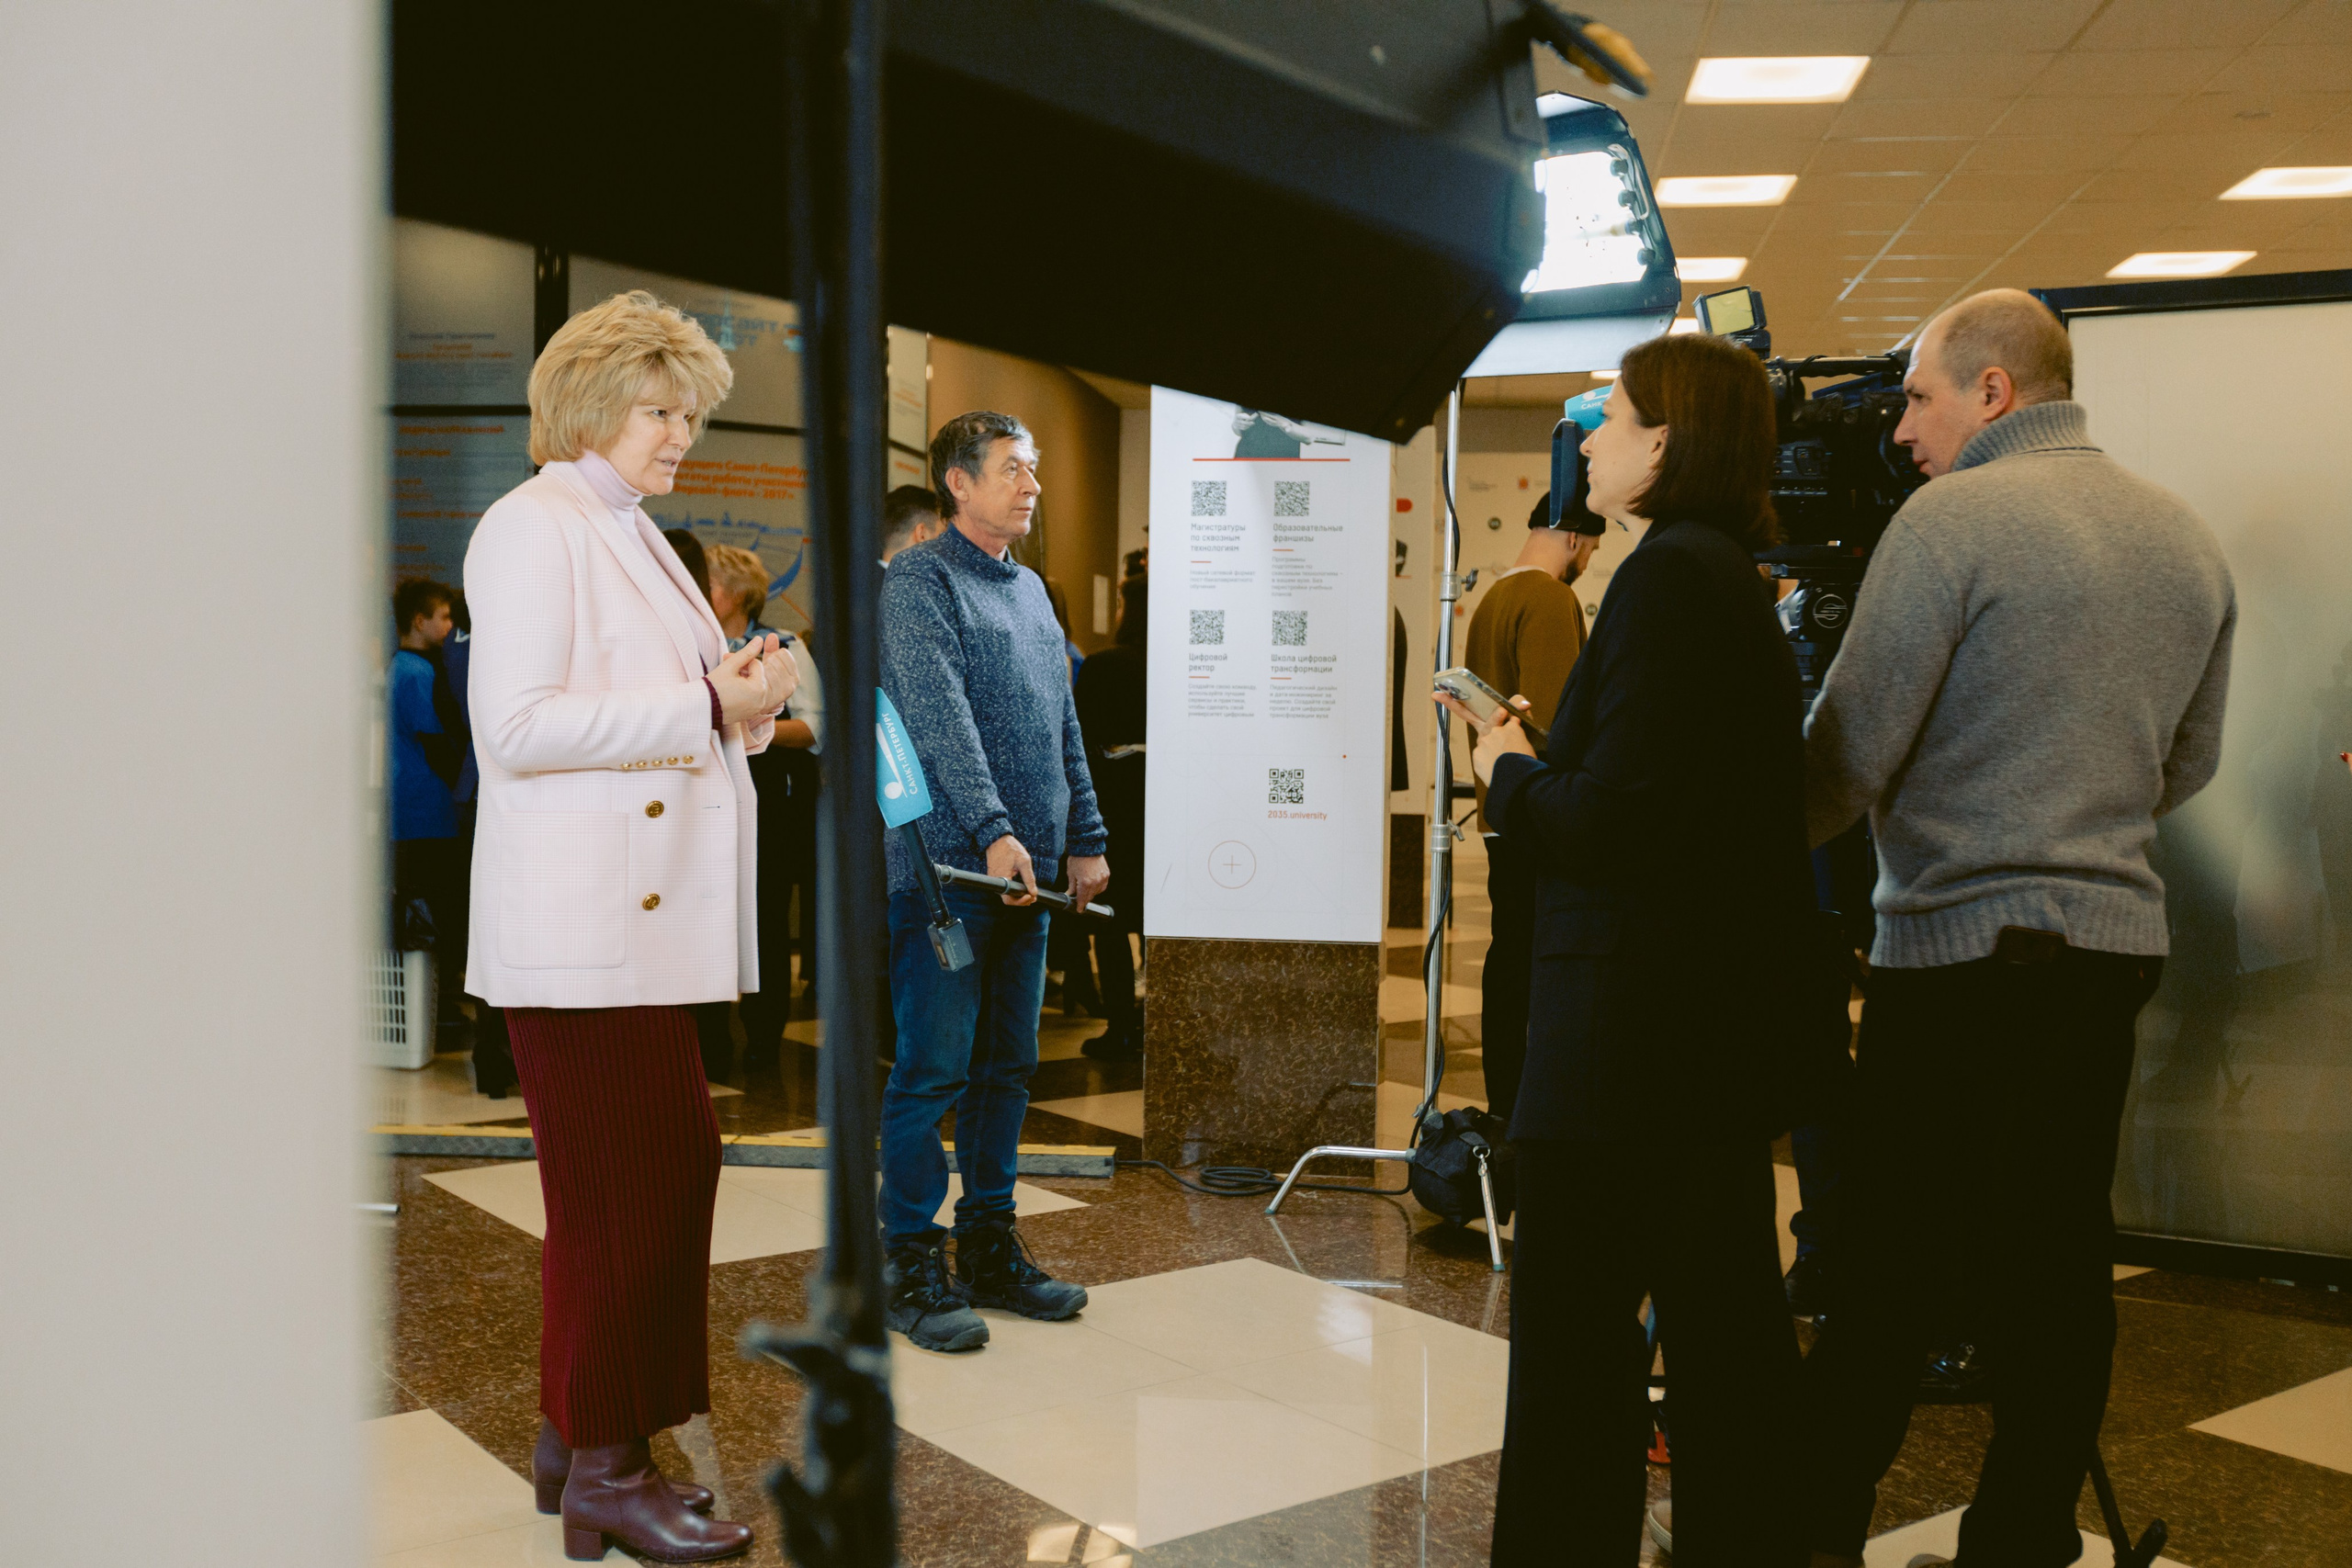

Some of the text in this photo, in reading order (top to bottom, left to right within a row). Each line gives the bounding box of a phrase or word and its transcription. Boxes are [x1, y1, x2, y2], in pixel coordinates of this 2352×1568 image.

[1581, 400, 1602, 410] САНК
[1191, 523, 1246, 533] Магистратуры
[1272, 523, 1343, 533] Образовательные
[1272, 534, 1314, 543] франшизы
[1189, 652, 1227, 662] Цифровой
[1271, 653, 1337, 664] Школа цифровой
[1189, 664, 1215, 672] ректор
[1271, 664, 1333, 674] трансформации
[1268, 810, 1327, 821] 2035.university
